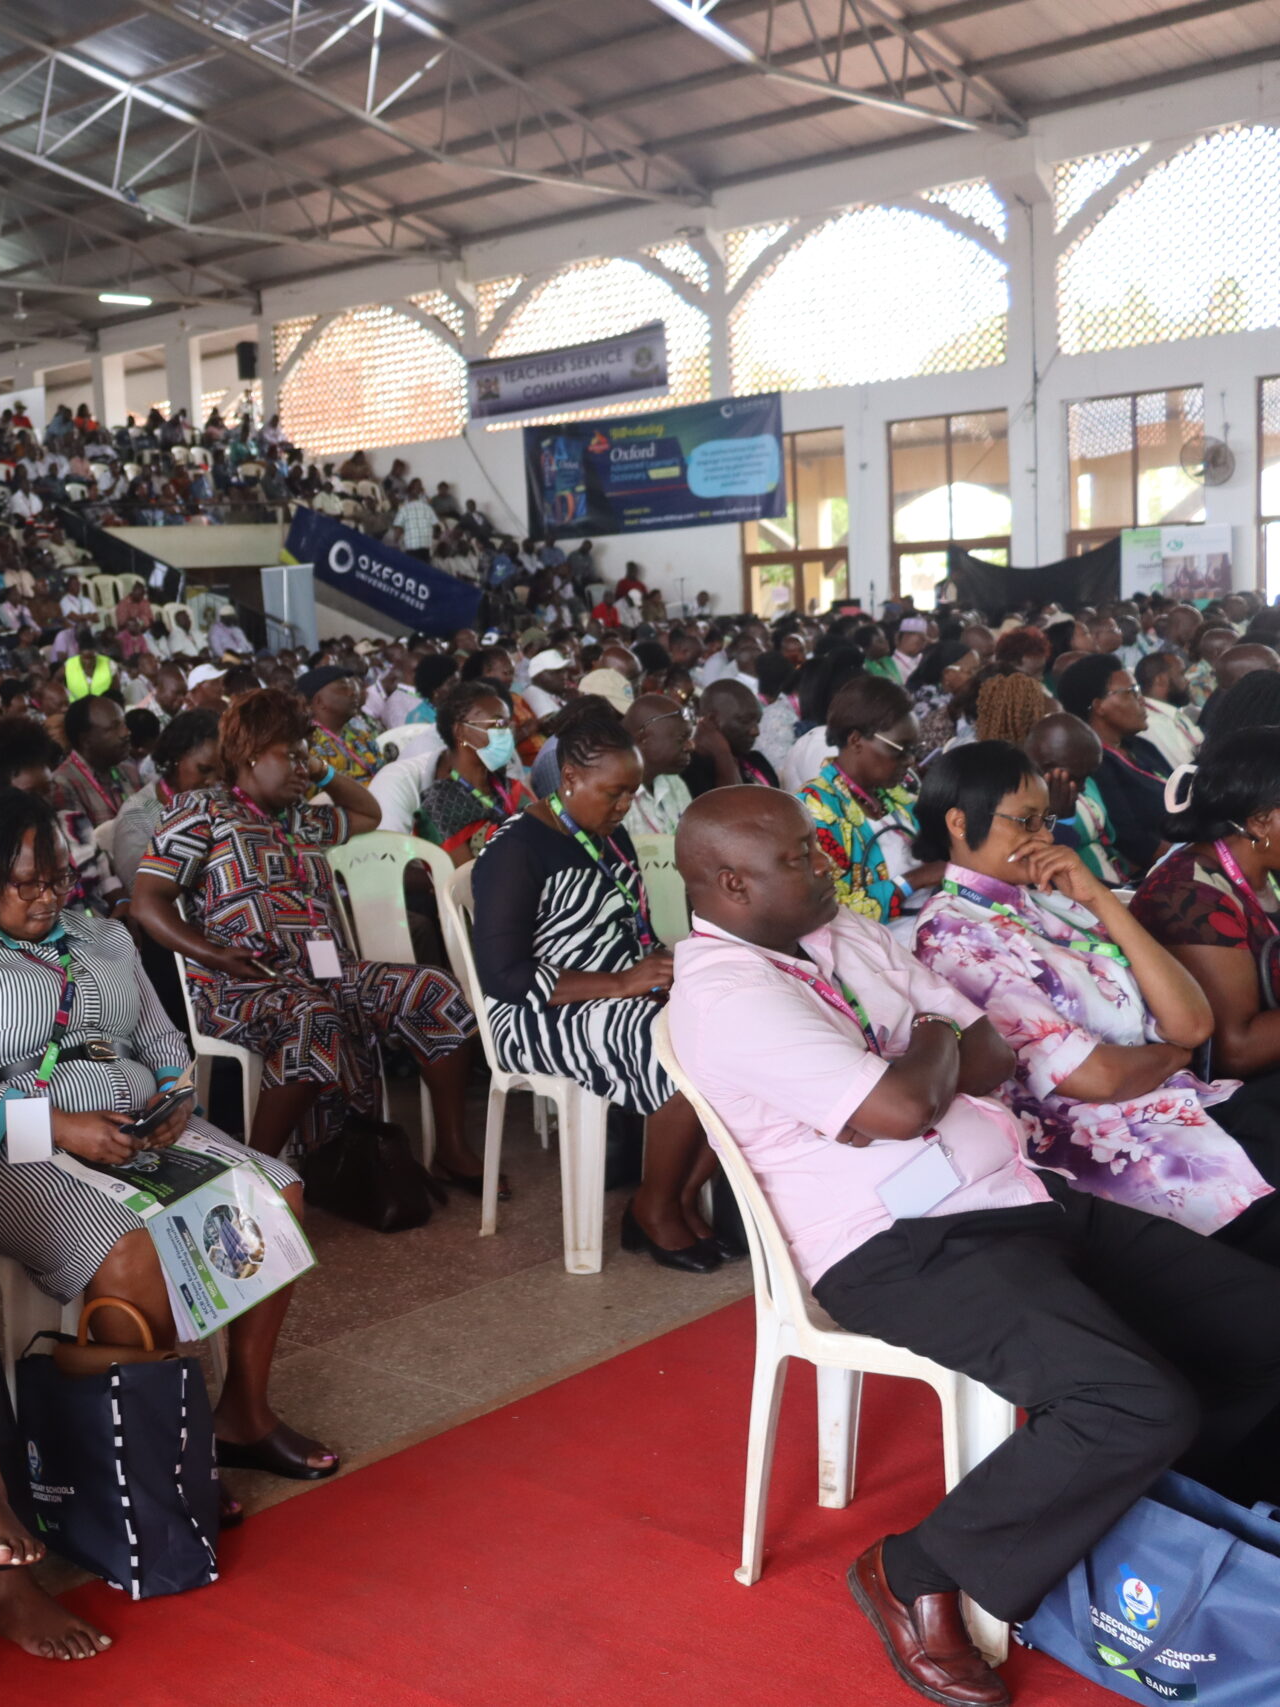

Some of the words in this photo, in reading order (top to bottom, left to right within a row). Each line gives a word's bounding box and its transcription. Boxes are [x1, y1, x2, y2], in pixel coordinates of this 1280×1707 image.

[503, 361, 567, 384] TEACHERS
[570, 349, 624, 371] SERVICE
[522, 372, 612, 400] COMMISSION
[609, 442, 655, 462] Oxford
[358, 555, 430, 600] OXFORD
[355, 570, 399, 598] UNIVERSITY
[400, 592, 426, 611] PRESS
[960, 888, 983, 902] BANK
[46, 1486, 75, 1495] SCHOOLS
[1145, 1676, 1178, 1697] BANK
